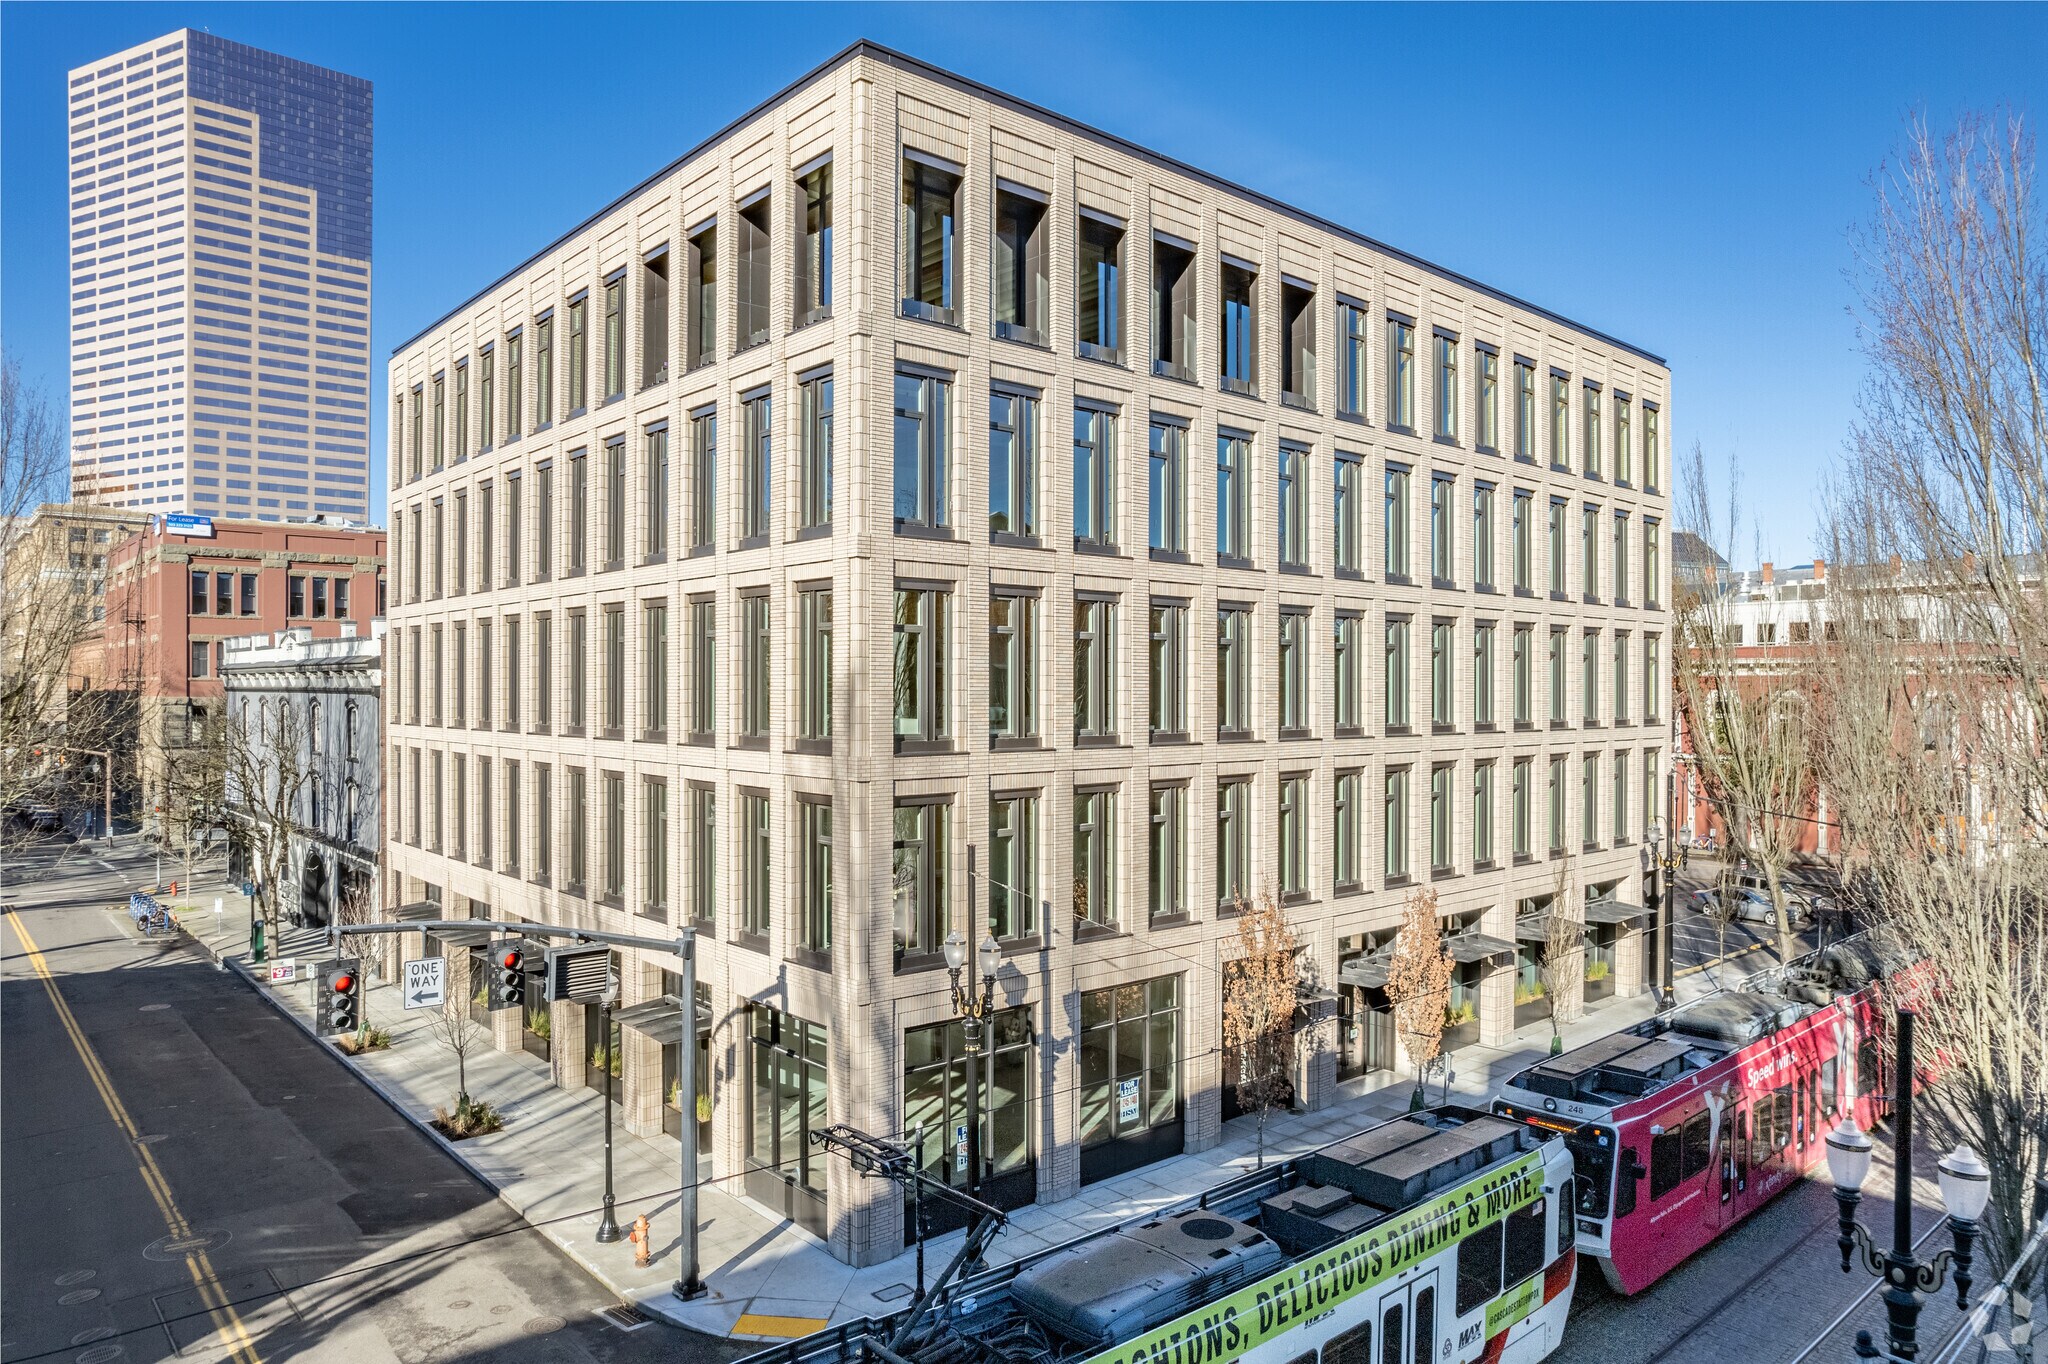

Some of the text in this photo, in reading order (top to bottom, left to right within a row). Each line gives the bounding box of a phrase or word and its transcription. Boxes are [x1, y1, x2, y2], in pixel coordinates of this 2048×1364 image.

[411, 962, 439, 976] ONE
[410, 974, 440, 989] WAY
[1747, 1050, 1798, 1090] Speed wins.
[1124, 1080, 1135, 1090] FOR
[1121, 1087, 1138, 1098] LEASE
[1567, 1105, 1584, 1115] 248
[1256, 1238, 1383, 1336] DELICIOUS
[1387, 1200, 1461, 1269] DINING
[1465, 1192, 1480, 1228] &
[1483, 1165, 1537, 1220] MORE.
[1458, 1320, 1482, 1348] MAX
